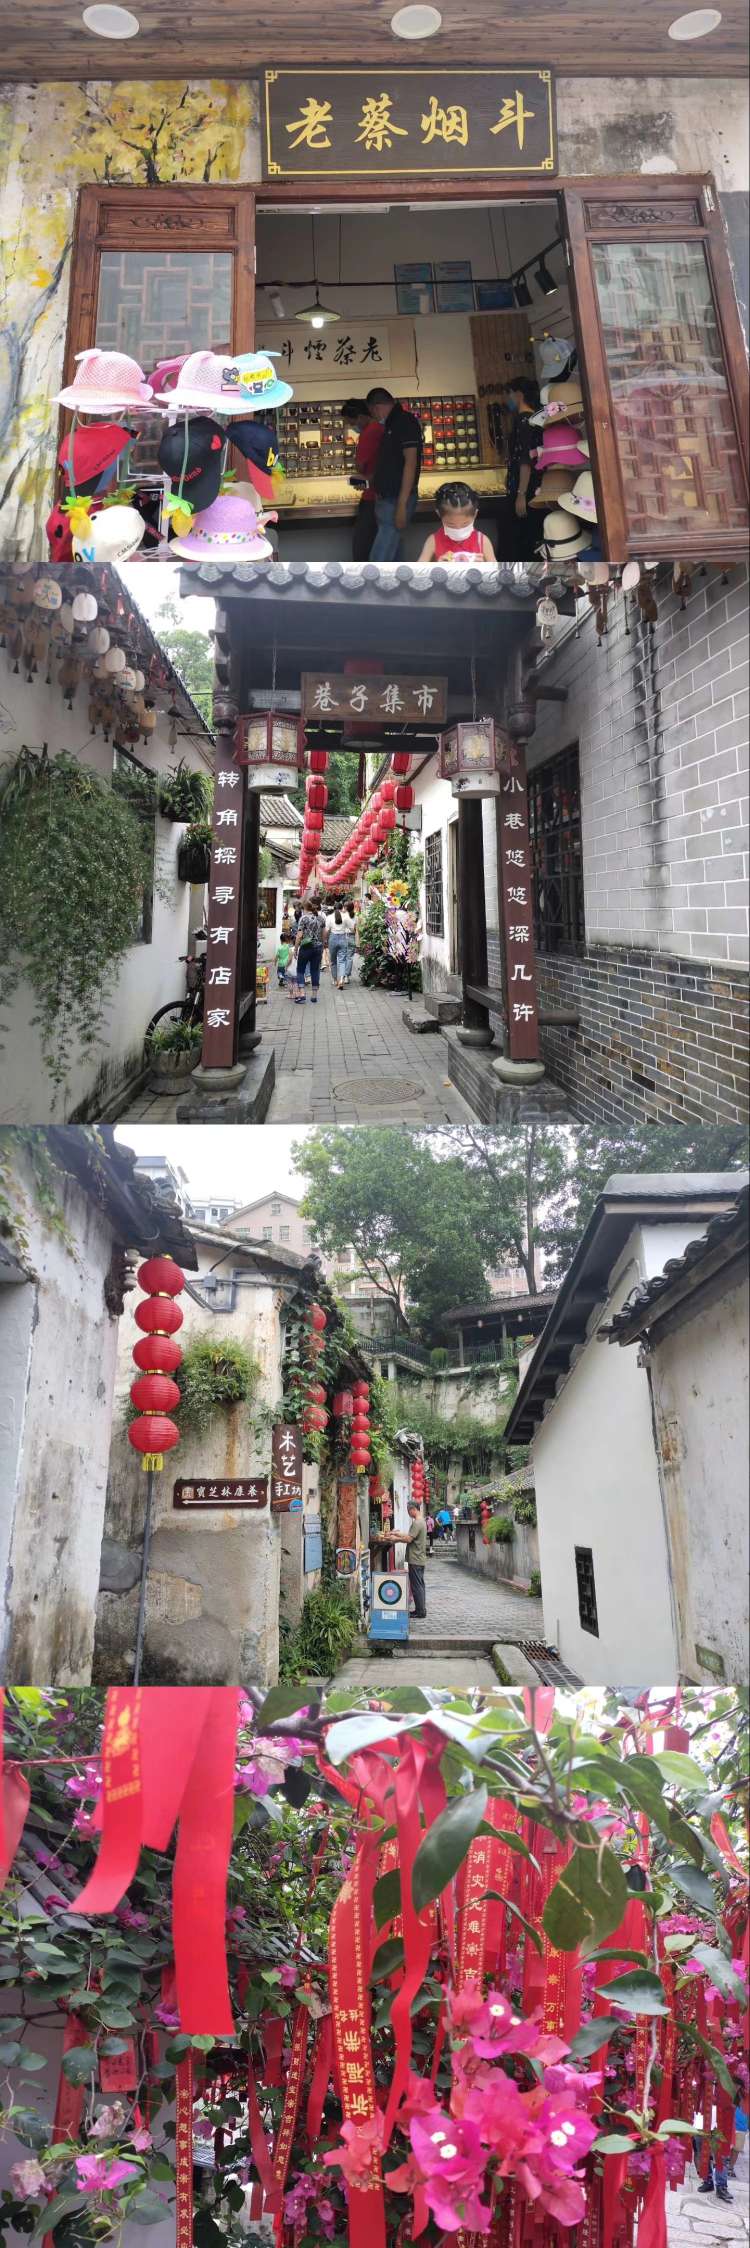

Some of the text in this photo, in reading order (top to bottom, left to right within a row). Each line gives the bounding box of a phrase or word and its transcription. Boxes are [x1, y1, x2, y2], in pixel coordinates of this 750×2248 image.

[285, 90, 535, 151] 老蔡烟斗
[312, 682, 439, 715] 巷子集市
[207, 771, 240, 1028] 转角探寻有店家
[503, 776, 535, 1023] 小巷悠悠深几许
[279, 1431, 296, 1477] 木艺
[343, 2030, 370, 2117] 祈福带
